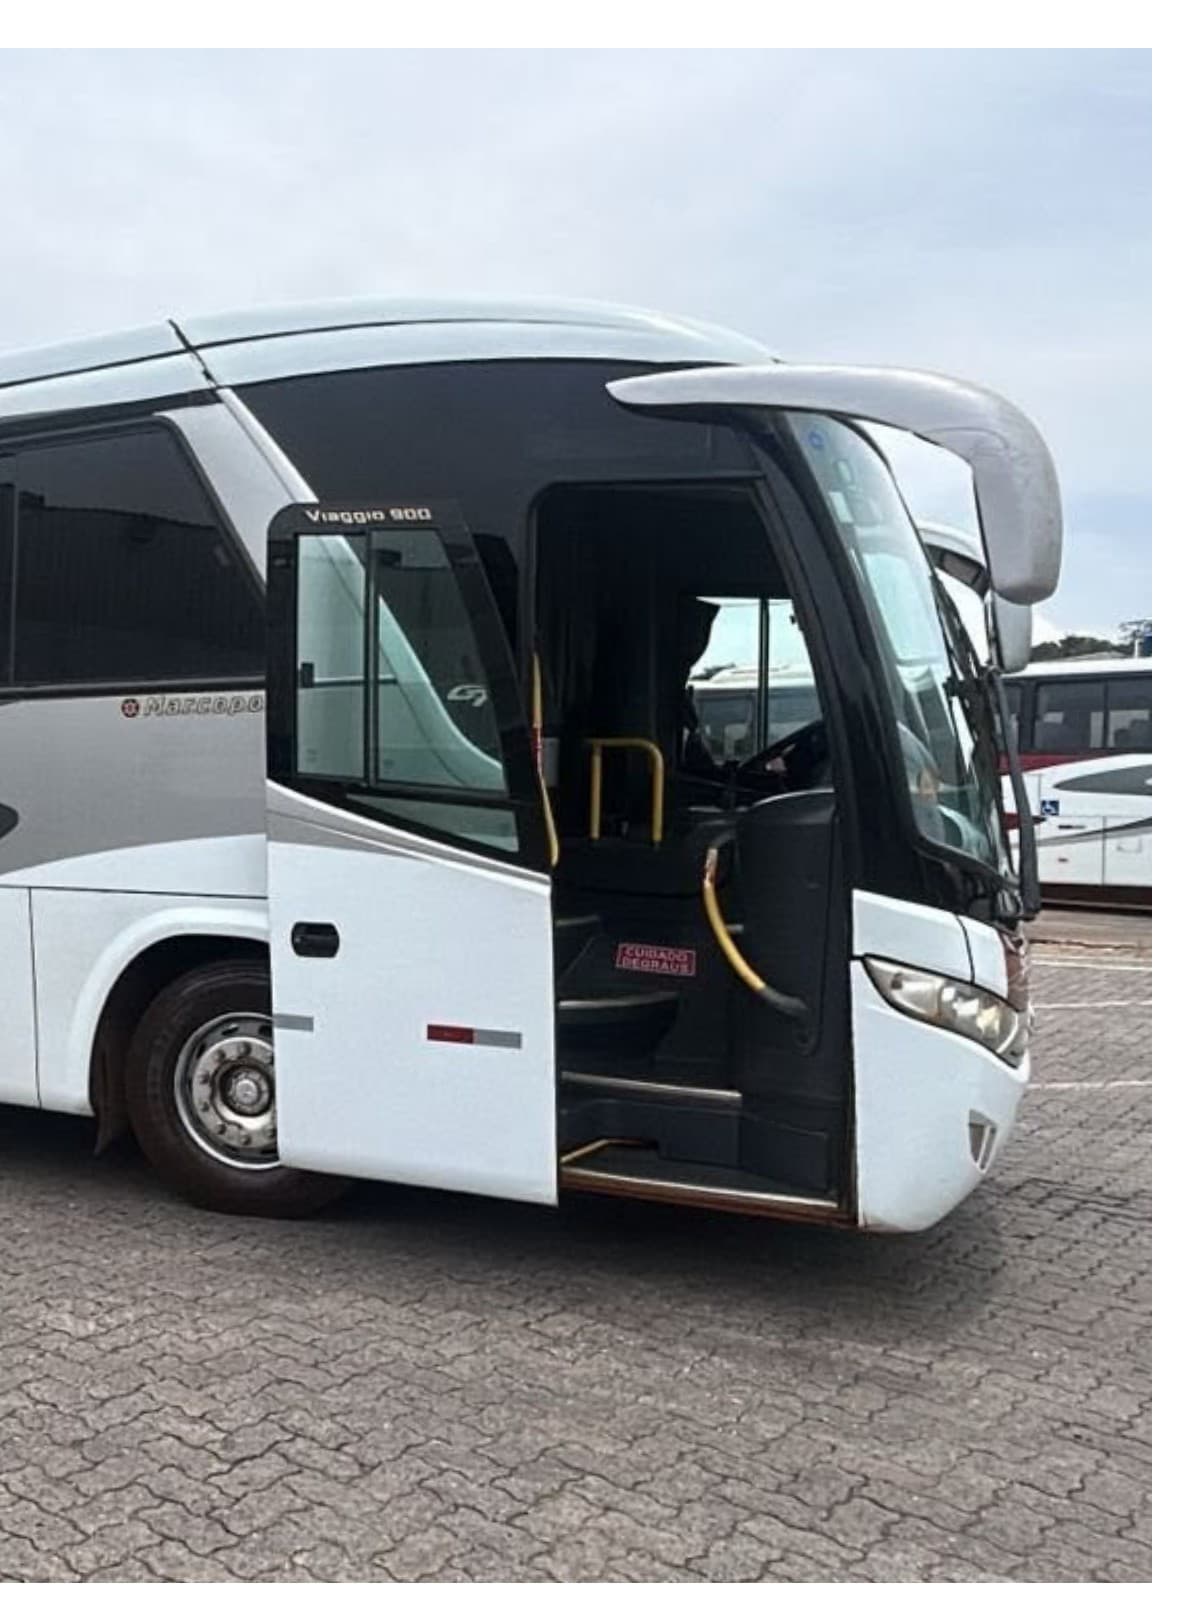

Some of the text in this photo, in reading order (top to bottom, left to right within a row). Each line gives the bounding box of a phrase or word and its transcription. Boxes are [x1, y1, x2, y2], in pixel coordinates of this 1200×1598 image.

[304, 507, 432, 524] Viaggio 900
[624, 946, 688, 962] CUIDADO
[622, 957, 689, 973] DEGRAUS
